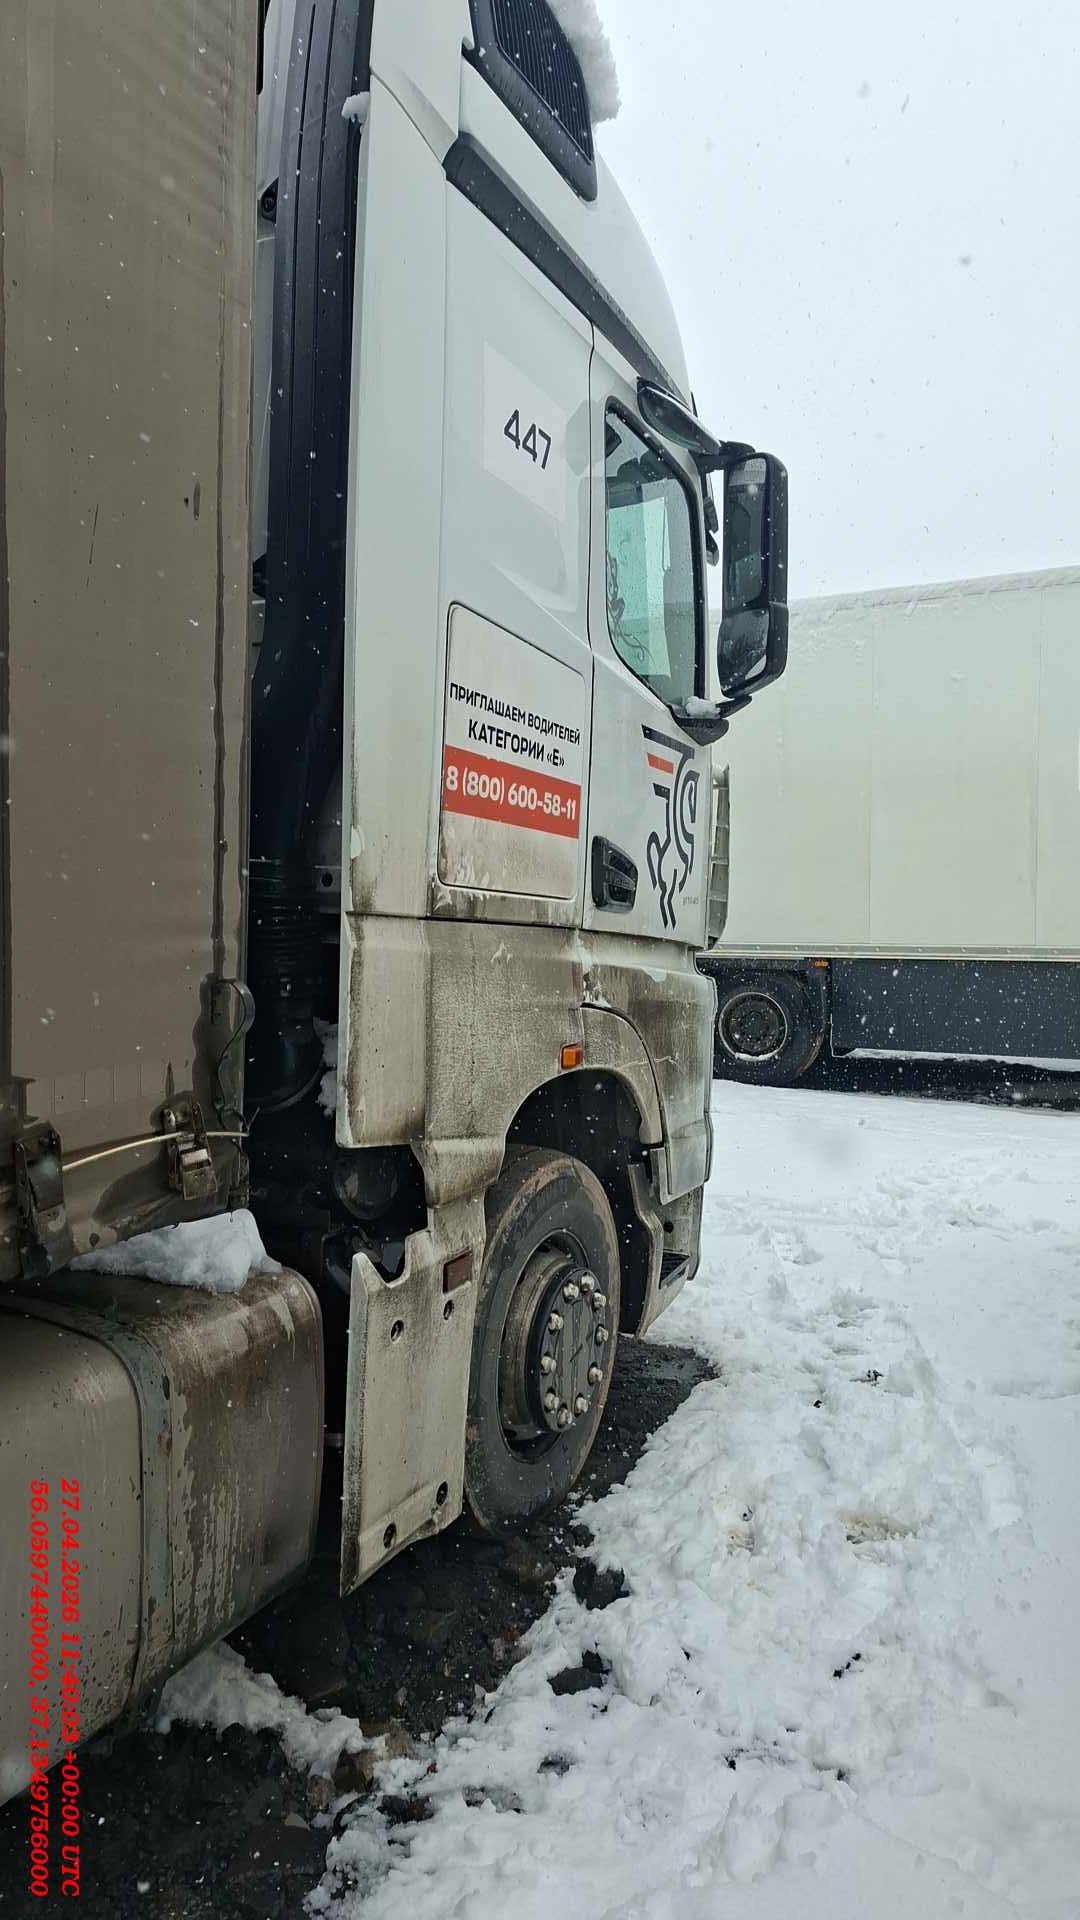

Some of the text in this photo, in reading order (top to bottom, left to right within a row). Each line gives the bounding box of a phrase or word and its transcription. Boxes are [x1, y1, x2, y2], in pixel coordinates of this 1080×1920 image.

[503, 408, 552, 470] 447
[449, 682, 580, 745] ПРИГЛАШАЕМ ВОДИТЕЛЕЙ
[468, 719, 565, 768] КАТЕГОРИИ «Е»
[446, 765, 576, 820] 8 (800) 600-58-11
